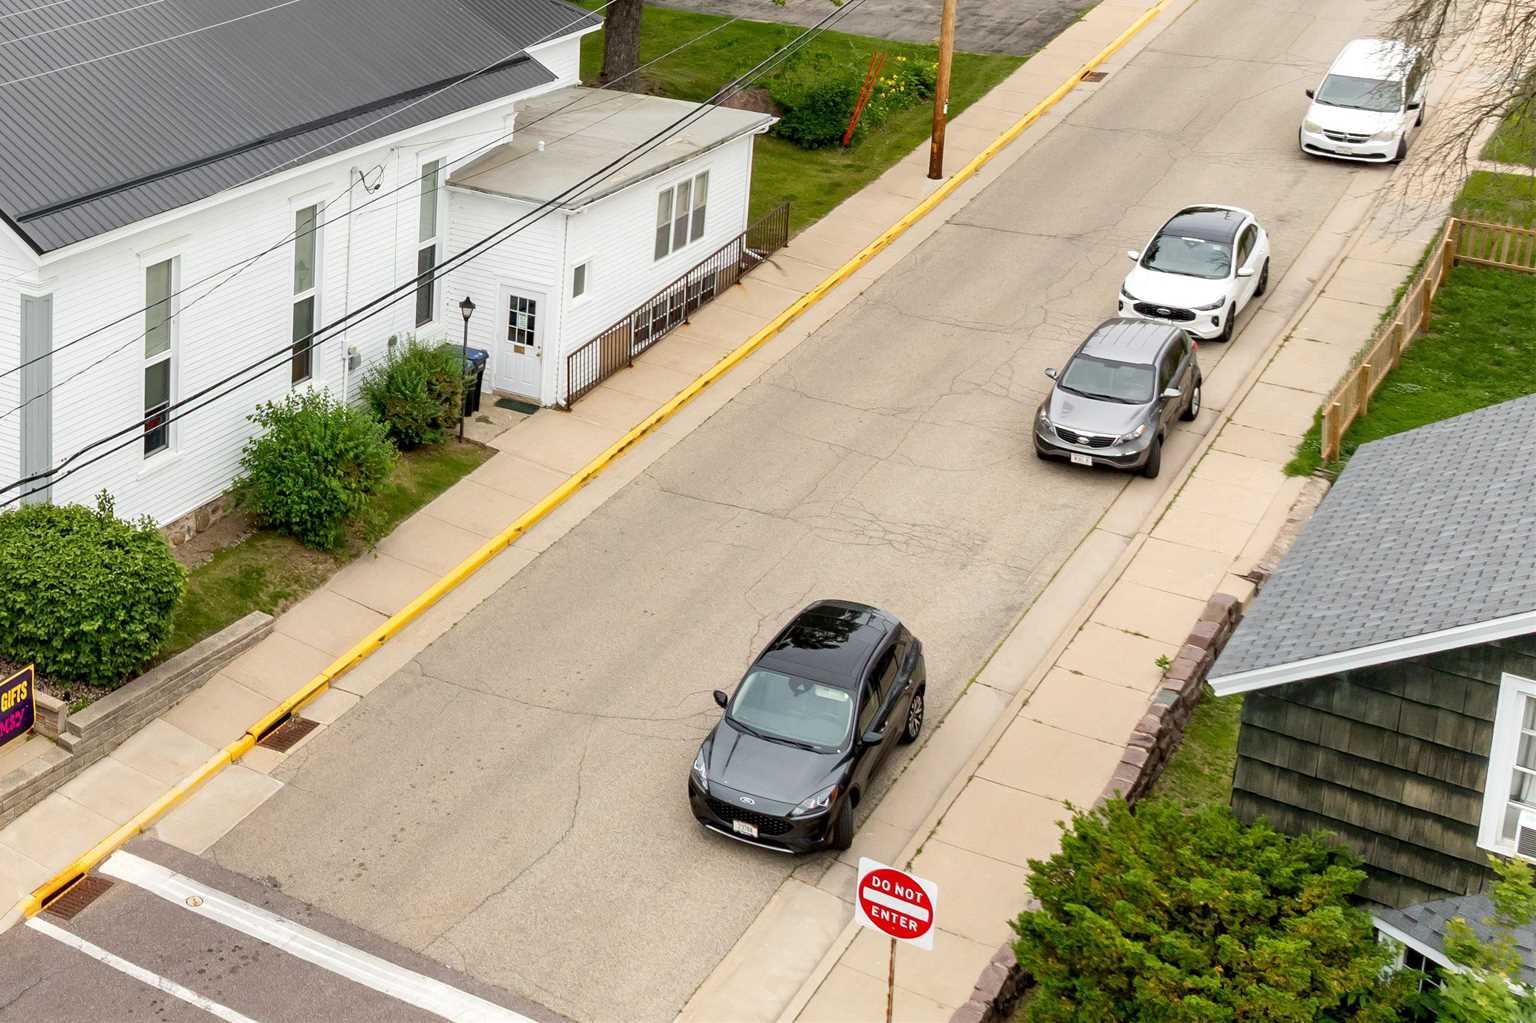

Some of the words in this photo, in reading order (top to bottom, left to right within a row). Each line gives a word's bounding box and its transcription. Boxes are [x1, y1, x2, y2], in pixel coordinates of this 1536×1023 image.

[1, 680, 28, 713] GIFTS
[872, 875, 891, 891] DO
[895, 882, 923, 904] NOT
[871, 906, 918, 932] ENTER
